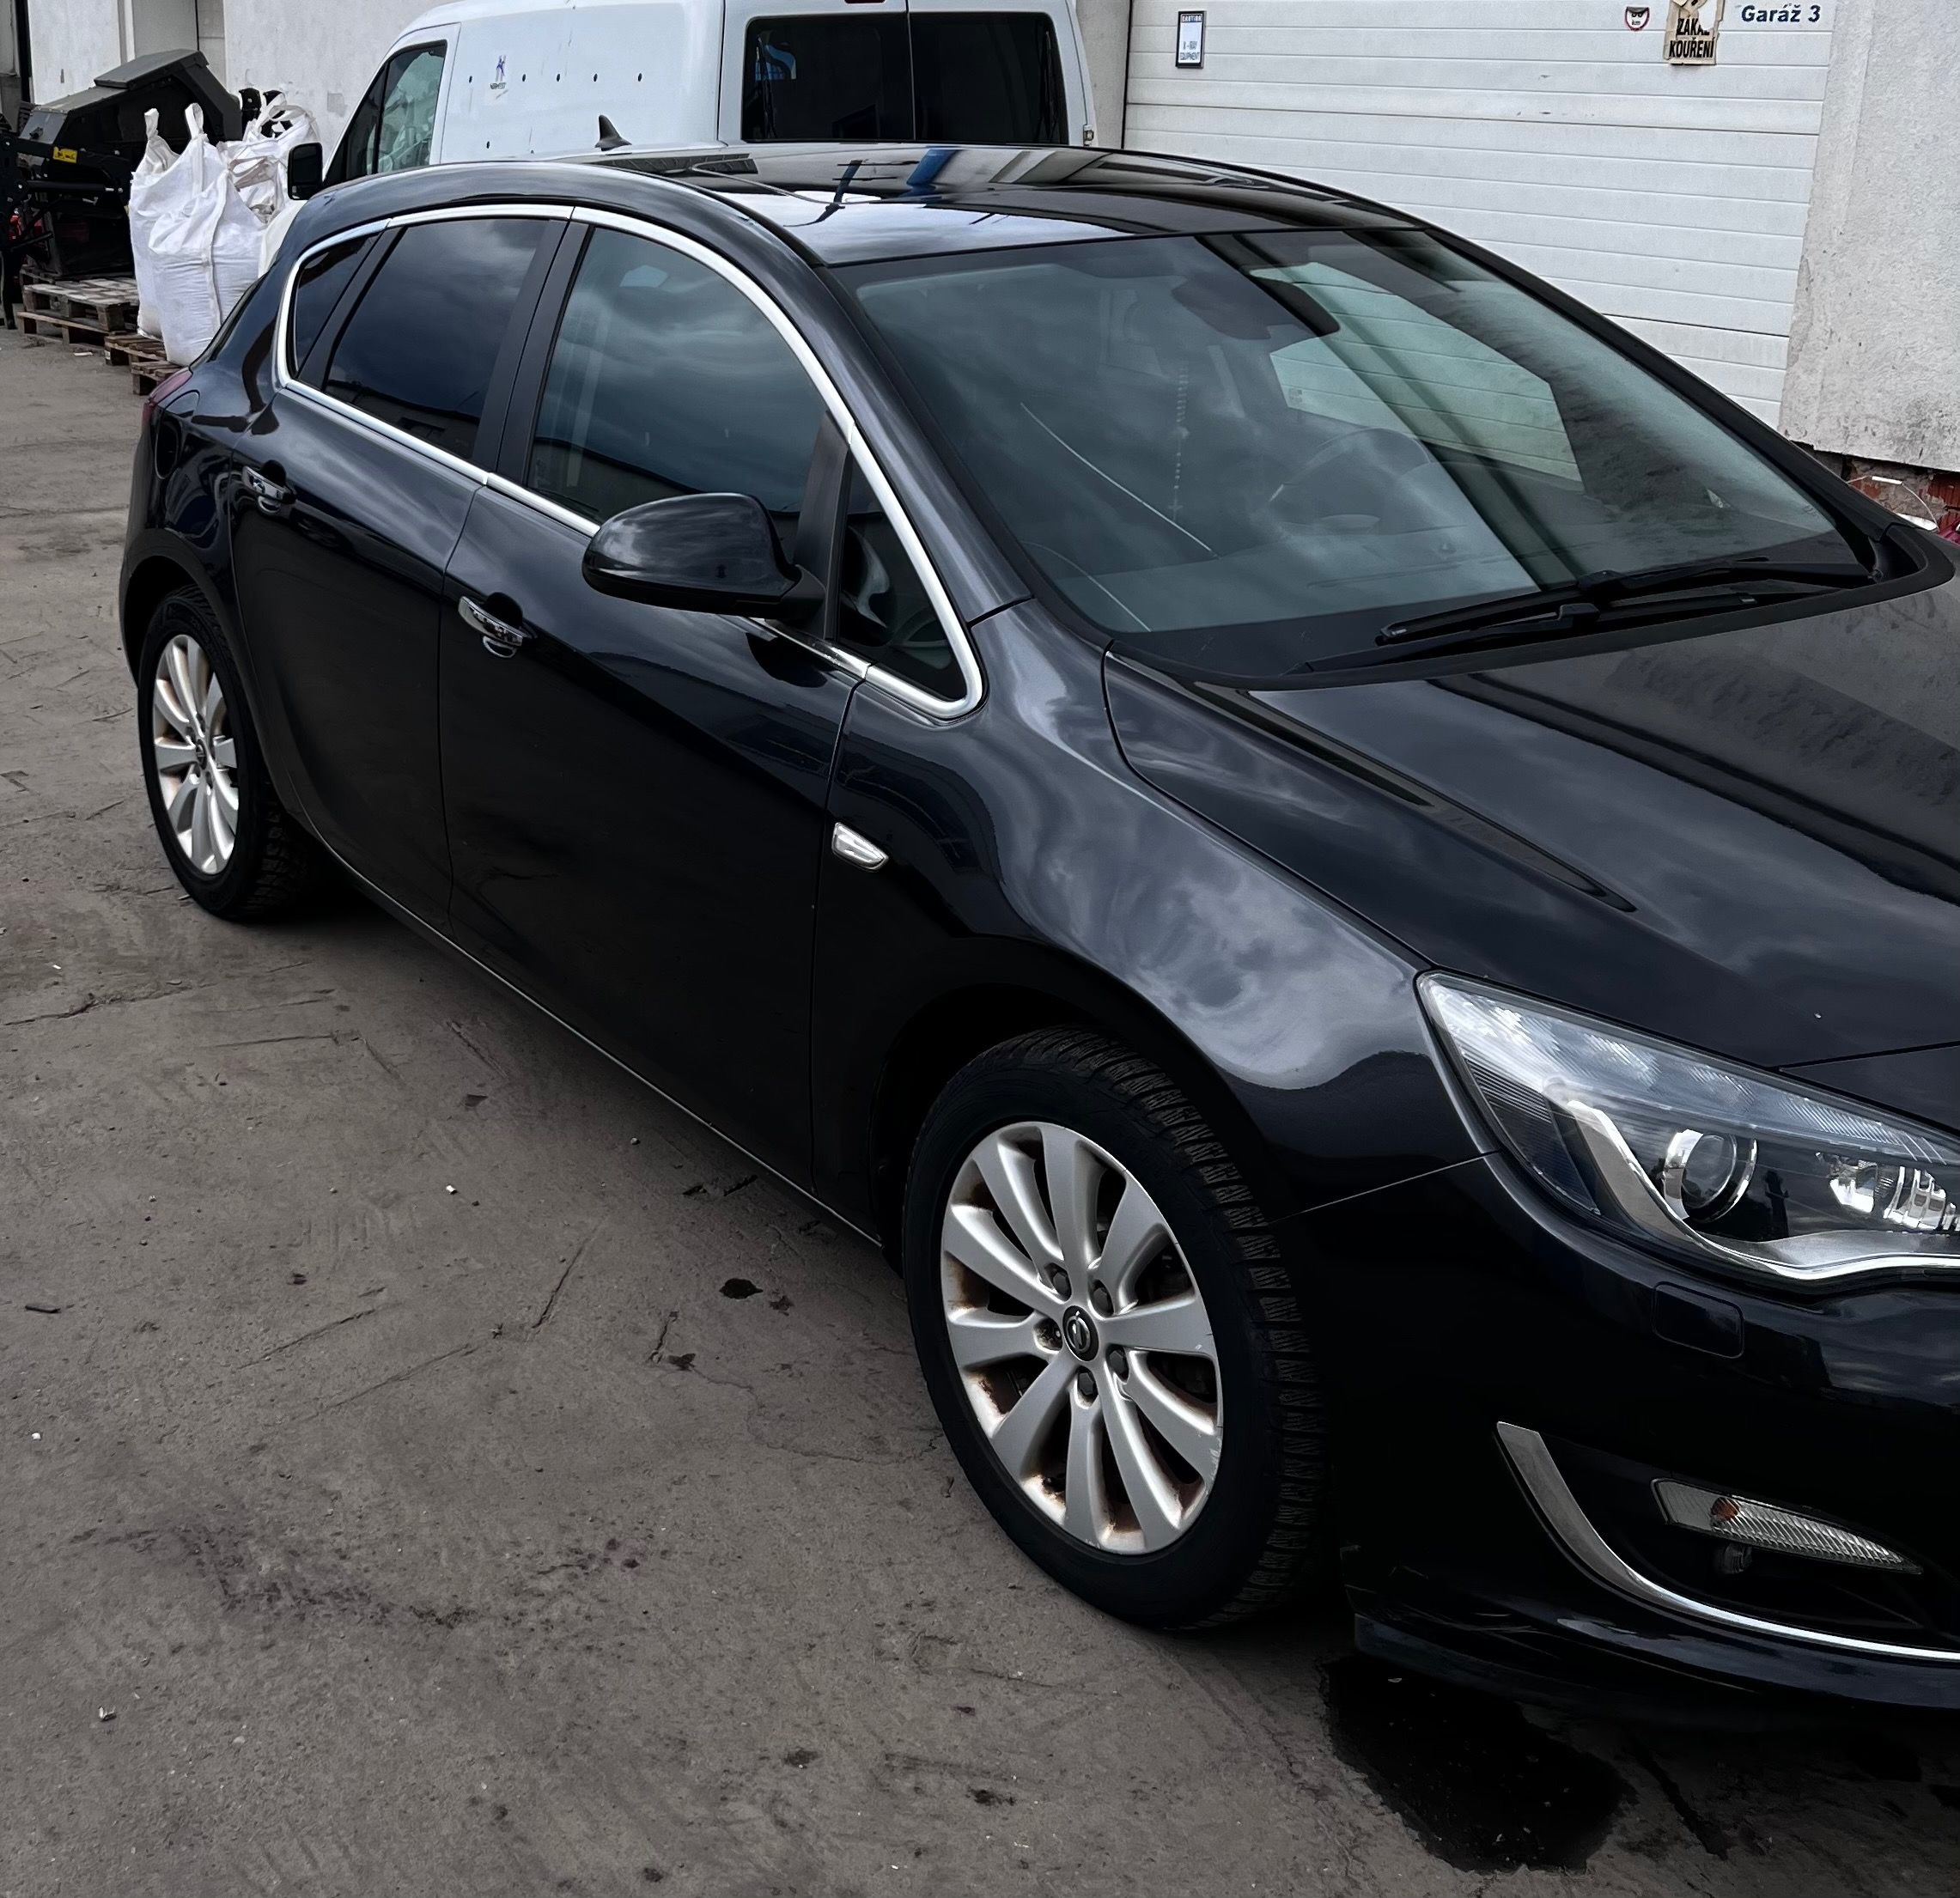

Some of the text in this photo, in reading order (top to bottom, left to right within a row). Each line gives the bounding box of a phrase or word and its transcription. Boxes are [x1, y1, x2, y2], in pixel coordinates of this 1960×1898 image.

[1742, 3, 1821, 22] Garáž 3
[1676, 15, 1710, 36] ZÁKA
[1668, 36, 1715, 58] KOUŘENÍ
